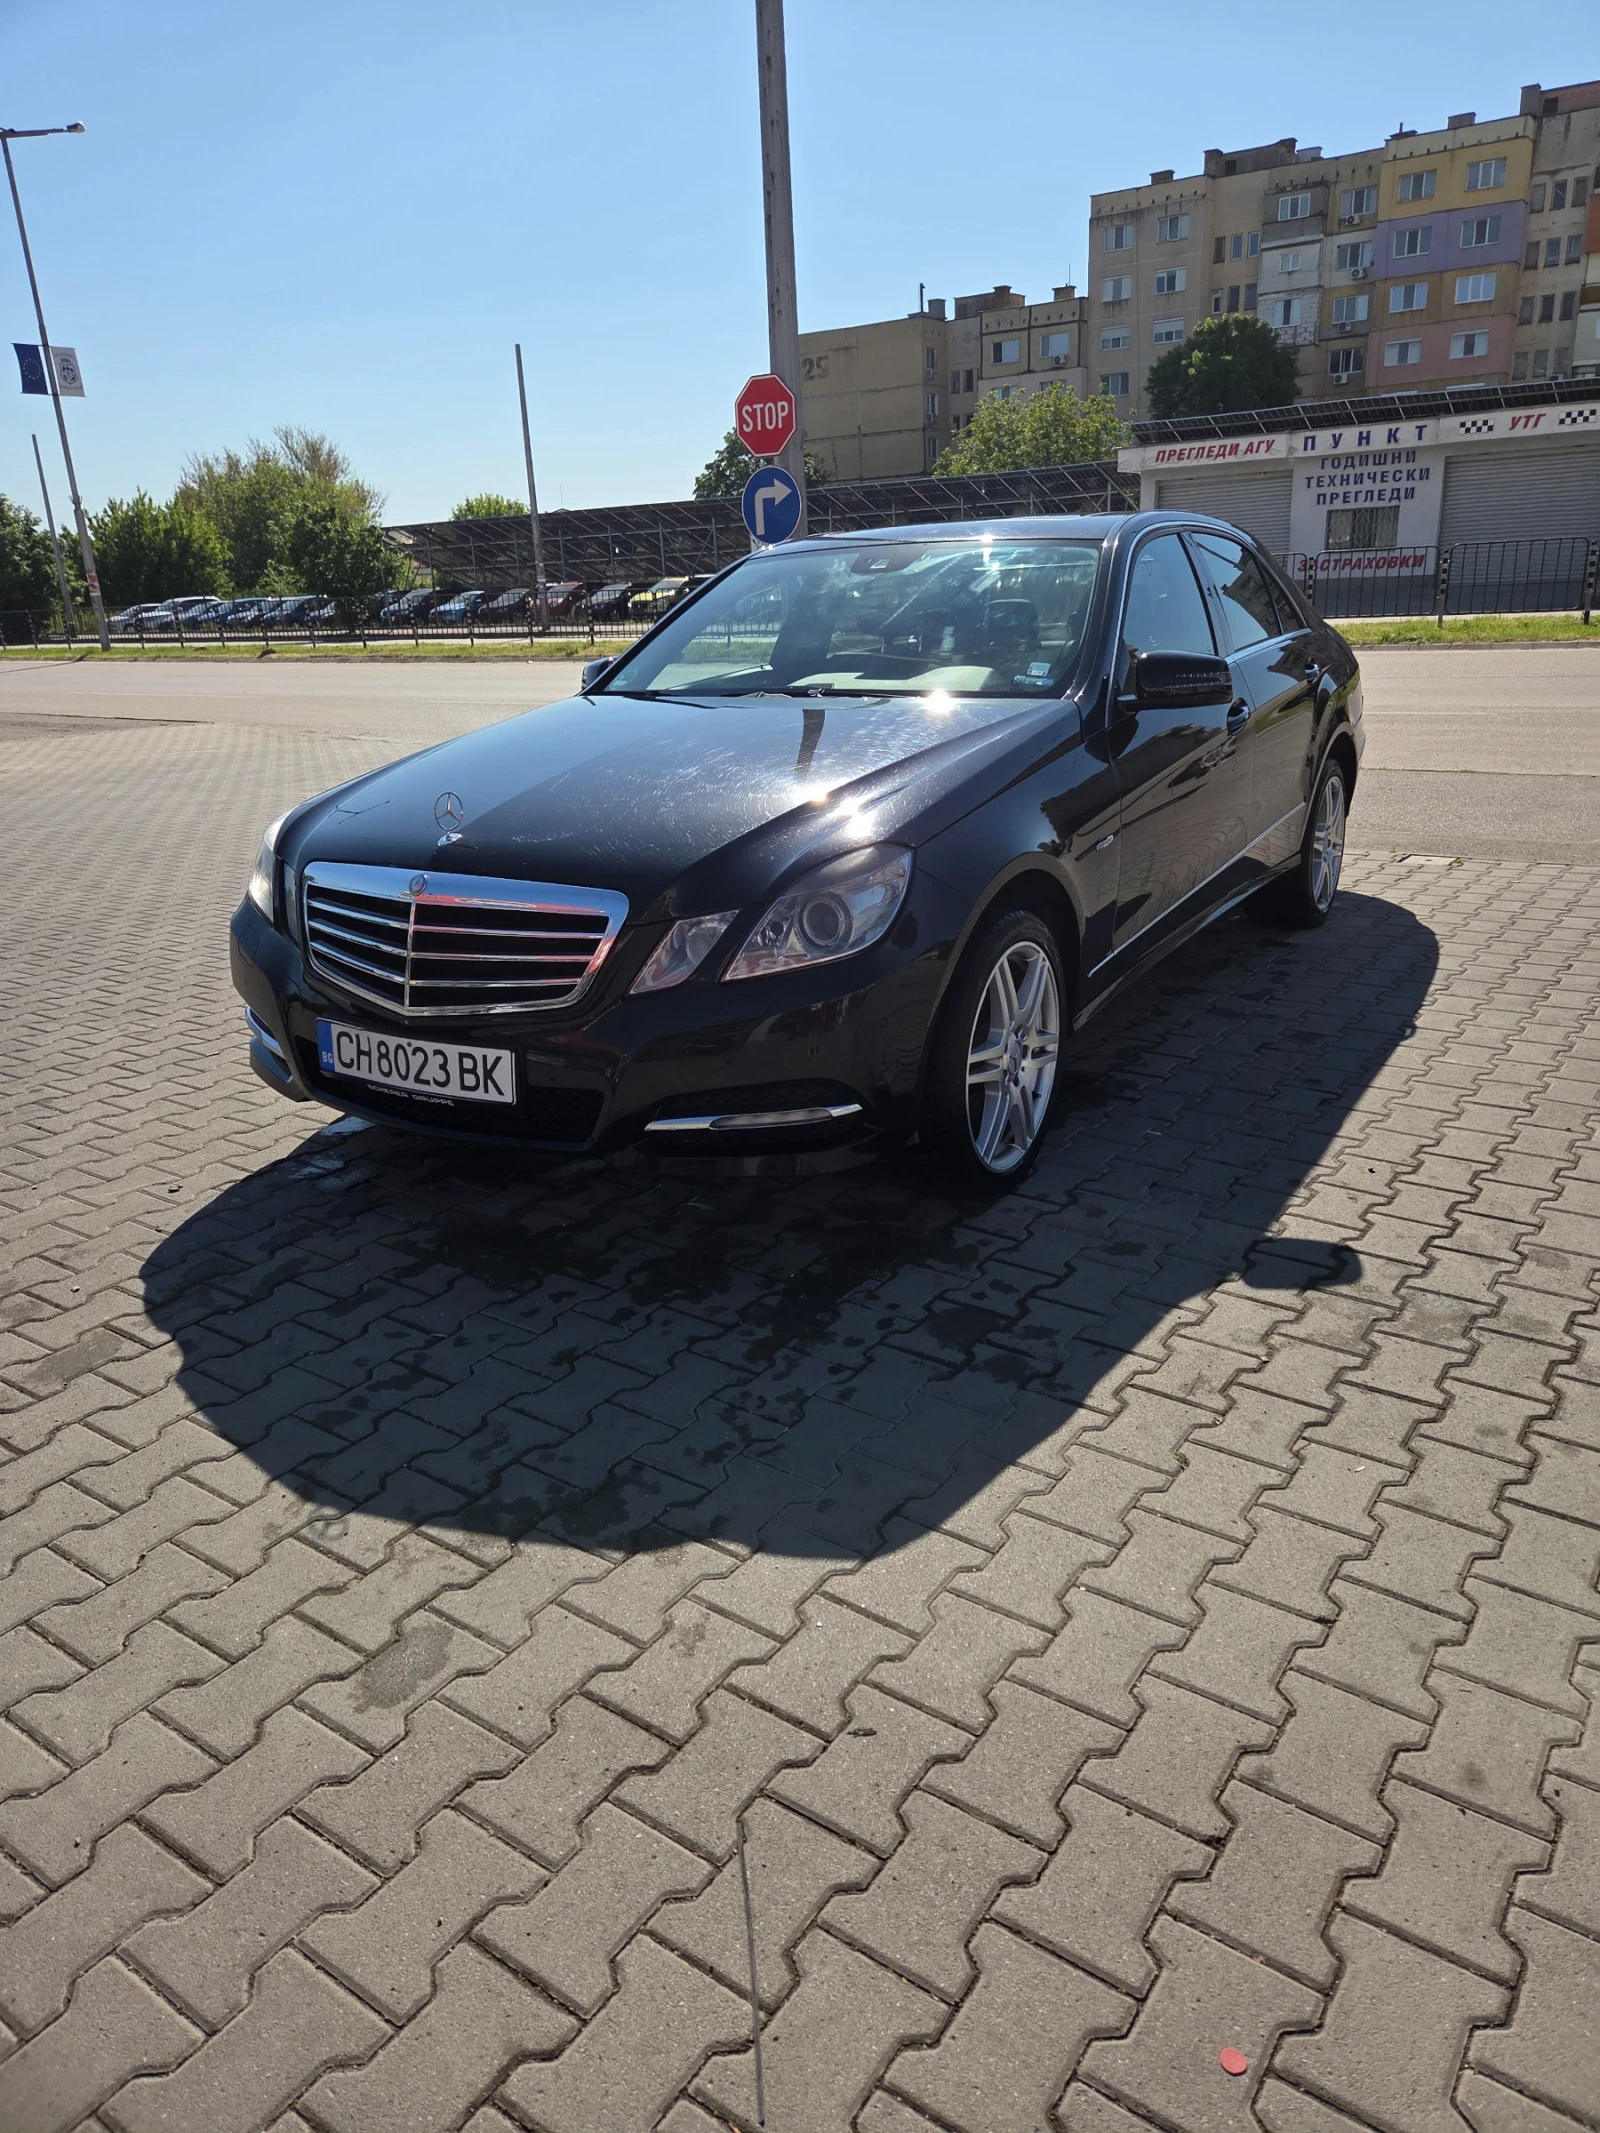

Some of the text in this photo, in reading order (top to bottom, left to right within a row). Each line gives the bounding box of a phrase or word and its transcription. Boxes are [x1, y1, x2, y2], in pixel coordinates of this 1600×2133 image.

[801, 355, 830, 381] 25
[741, 401, 789, 433] STOP
[1508, 413, 1547, 431] УТГ
[1303, 424, 1428, 452] ПУНКТ
[1155, 439, 1276, 463] ПРЕГЛЕДИ АГУ
[1320, 450, 1417, 471] ГОДИШНИ
[1304, 467, 1431, 489] ТЕХНИЧЕСКИ
[1316, 486, 1416, 506] ПРЕГЛЕДИ
[1297, 554, 1427, 573] ЗСТРАХОВКИ
[322, 1051, 334, 1064] BG
[411, 1094, 455, 1107] GRUPPE
